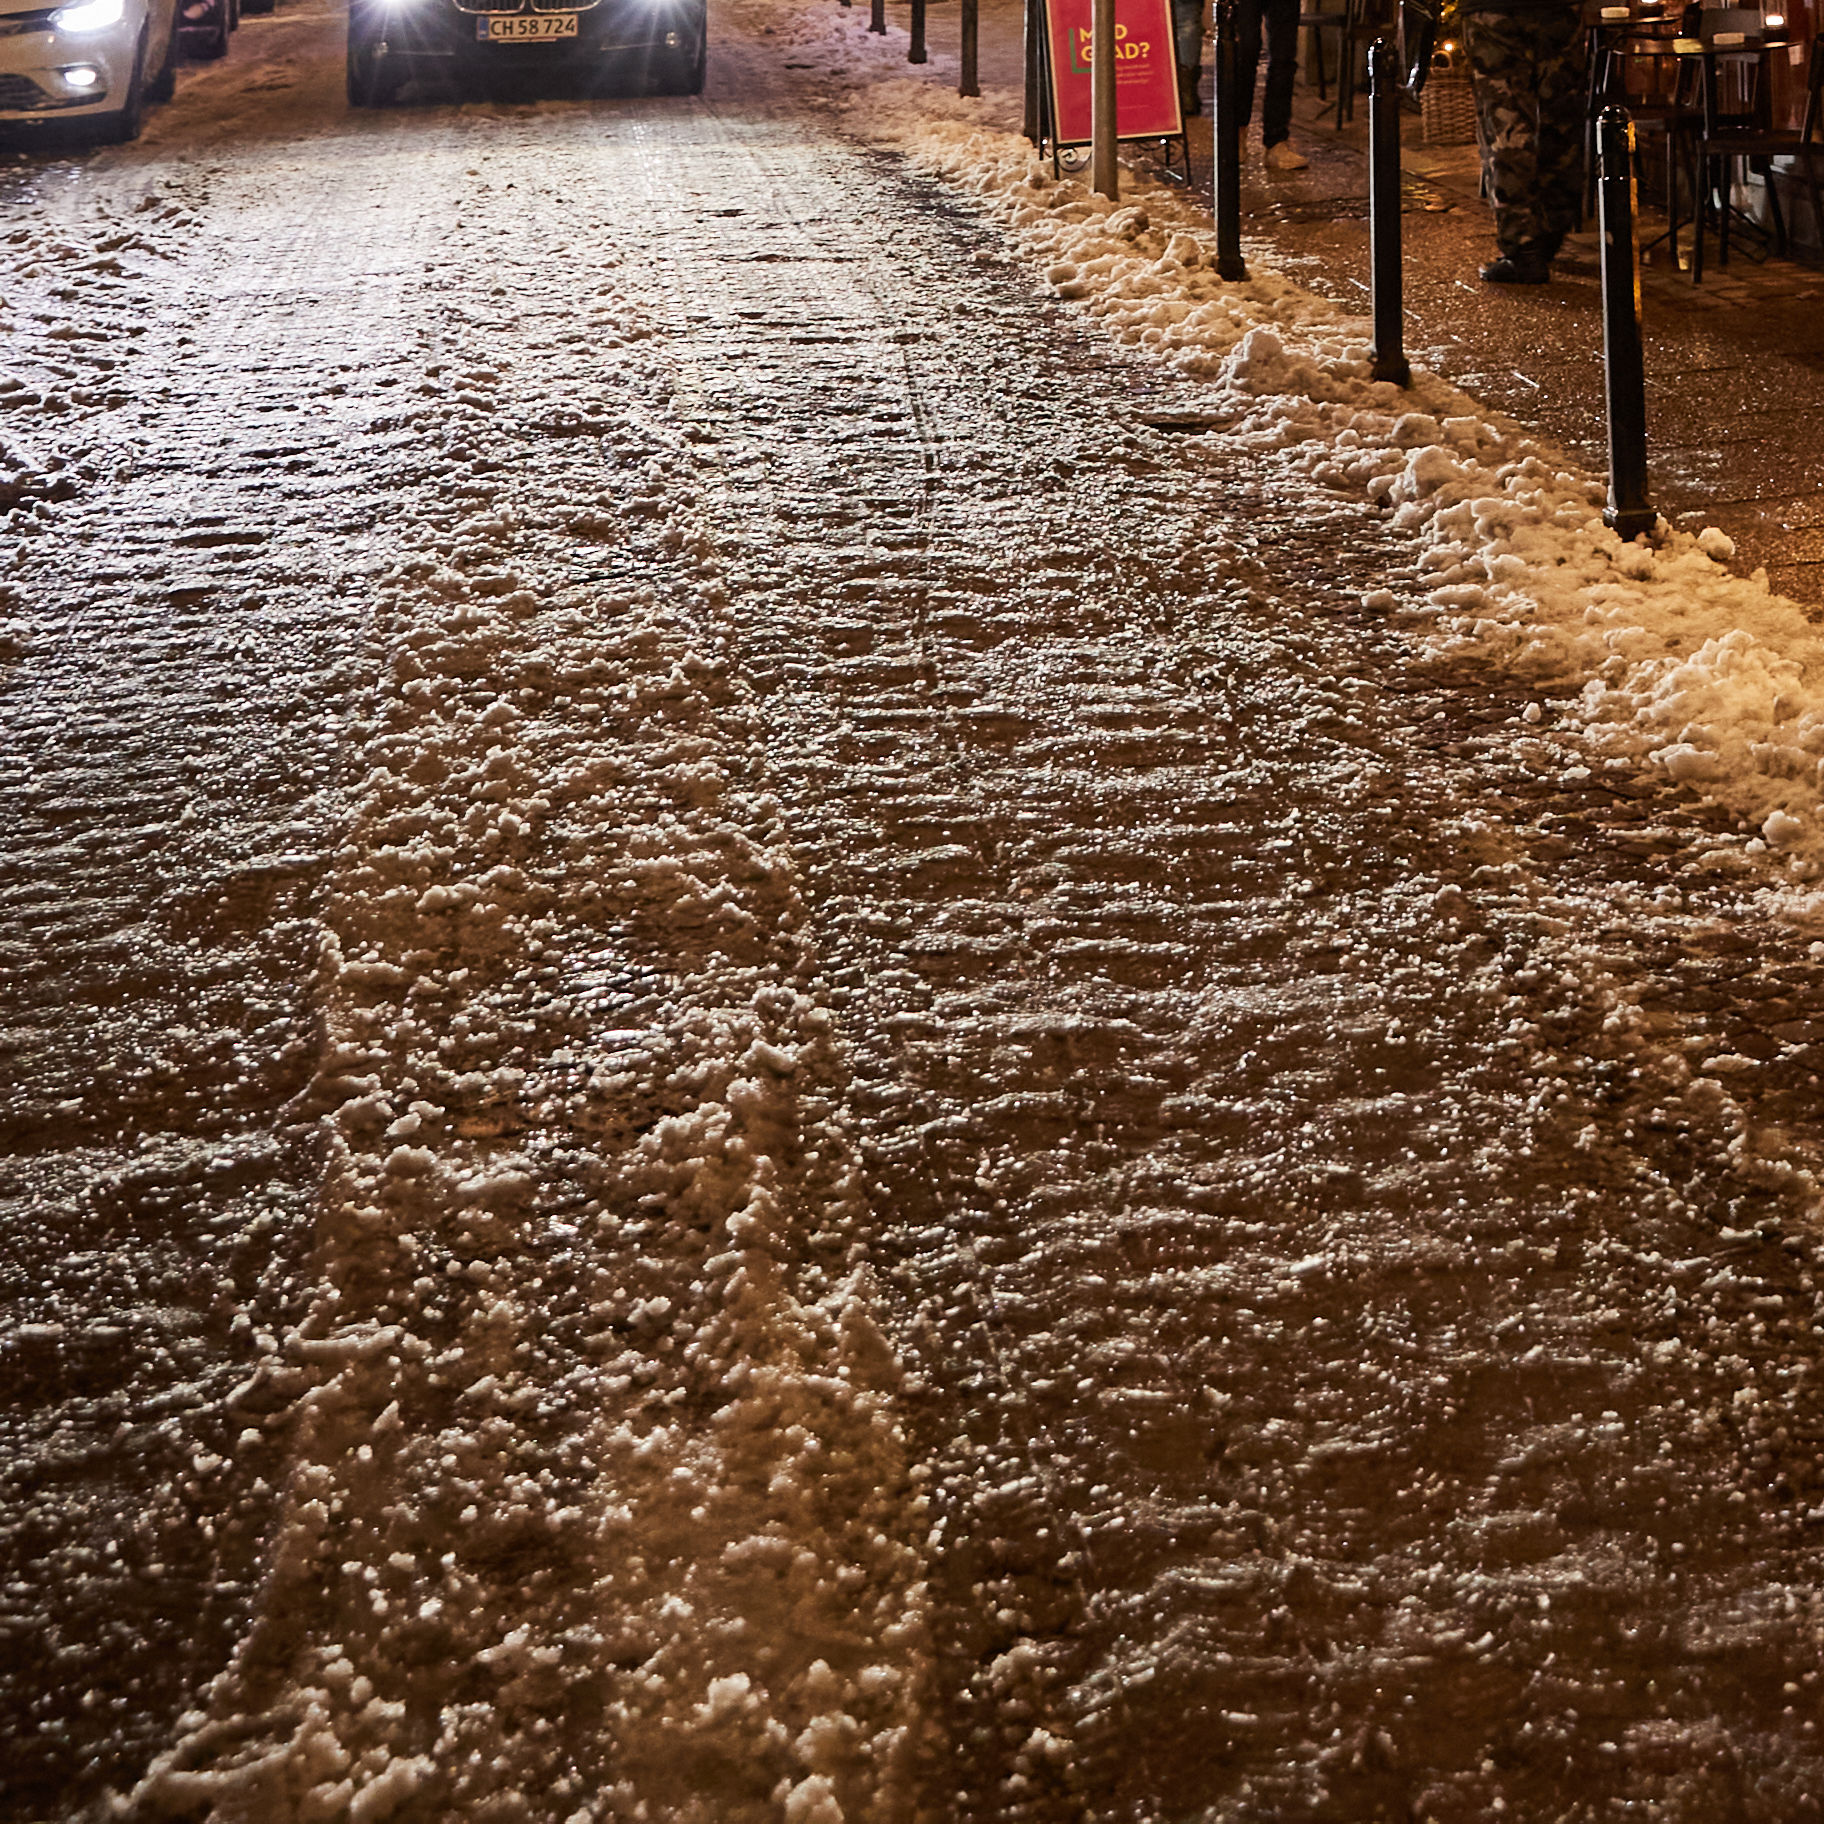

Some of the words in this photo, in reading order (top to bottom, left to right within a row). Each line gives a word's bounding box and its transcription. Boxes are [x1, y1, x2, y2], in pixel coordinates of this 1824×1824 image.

[490, 19, 514, 36] CH
[518, 18, 539, 35] 58
[543, 17, 576, 34] 724
[1079, 23, 1128, 43] MD
